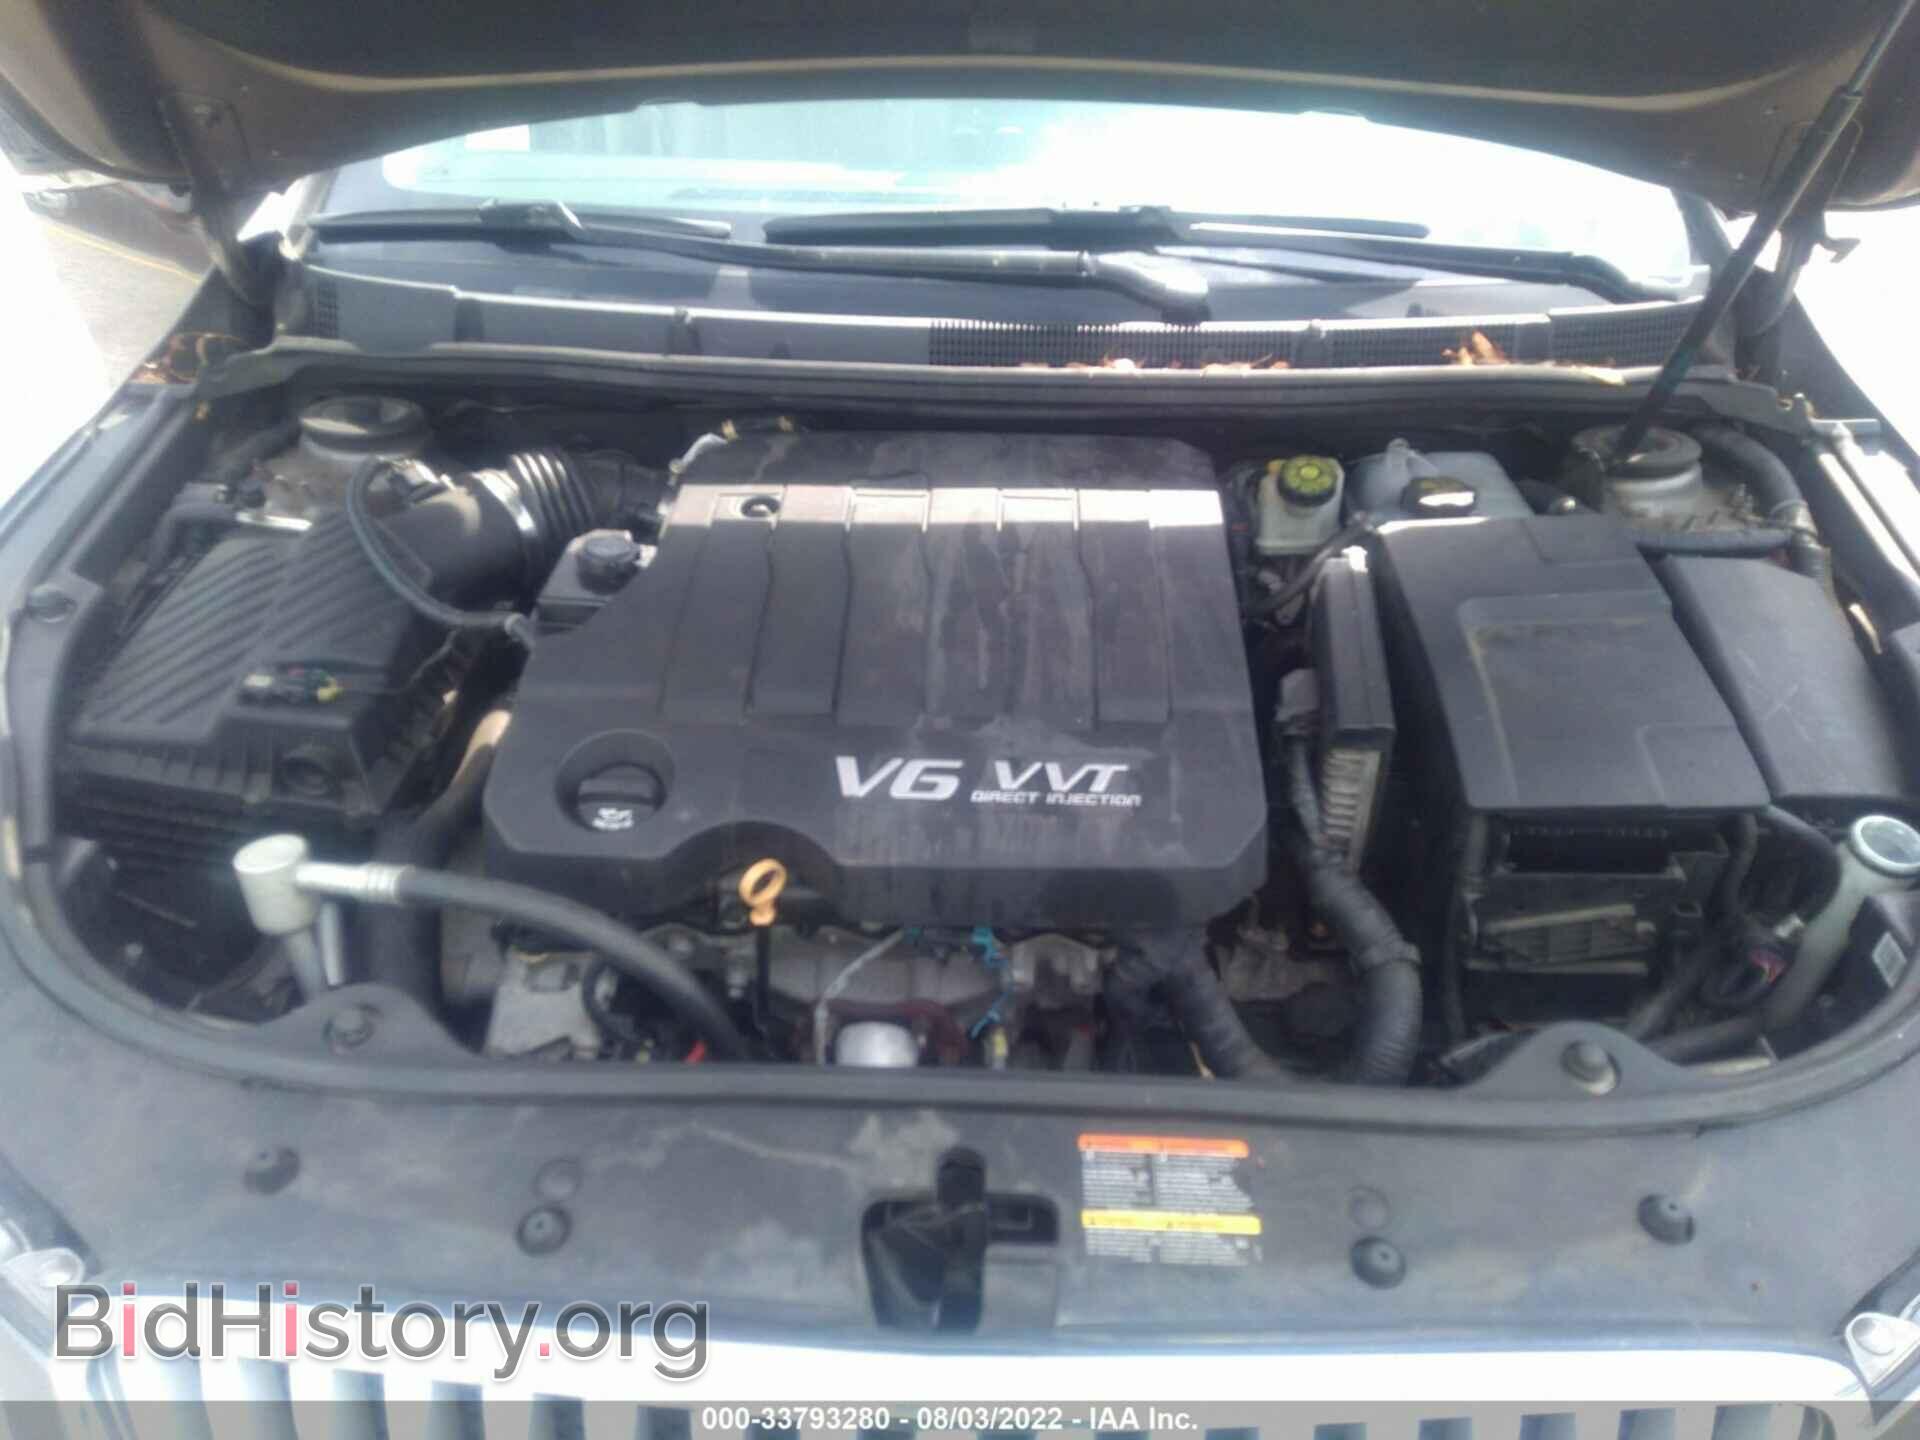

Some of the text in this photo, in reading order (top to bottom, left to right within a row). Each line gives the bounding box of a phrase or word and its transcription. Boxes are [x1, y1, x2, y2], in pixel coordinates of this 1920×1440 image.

[836, 756, 1129, 800] V6 VVT
[970, 790, 1142, 807] DIRECT INJECTION
